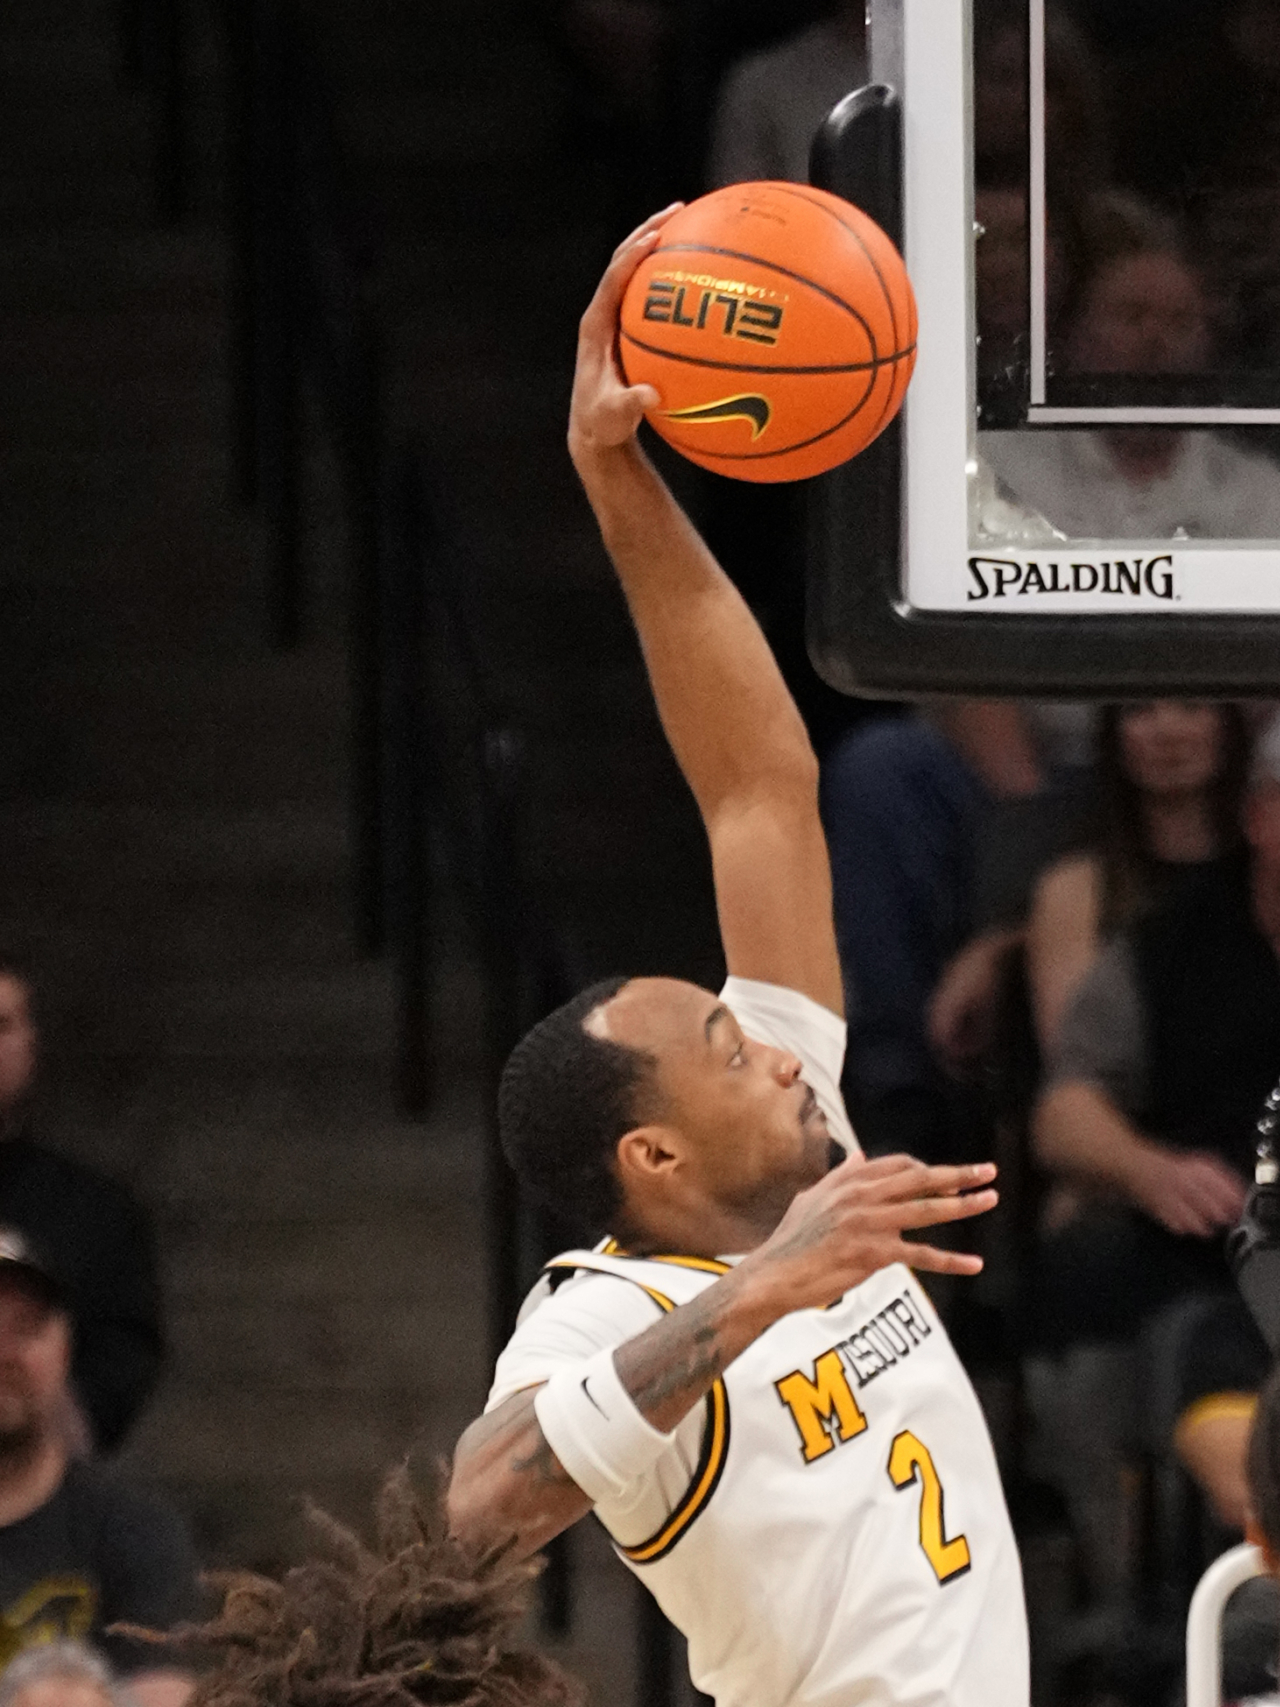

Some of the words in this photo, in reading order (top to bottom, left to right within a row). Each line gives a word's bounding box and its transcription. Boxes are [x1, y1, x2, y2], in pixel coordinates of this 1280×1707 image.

[643, 280, 784, 346] ELITE
[967, 555, 1174, 600] SPALDING
[774, 1290, 932, 1466] MISSOURI
[887, 1429, 972, 1588] 2
